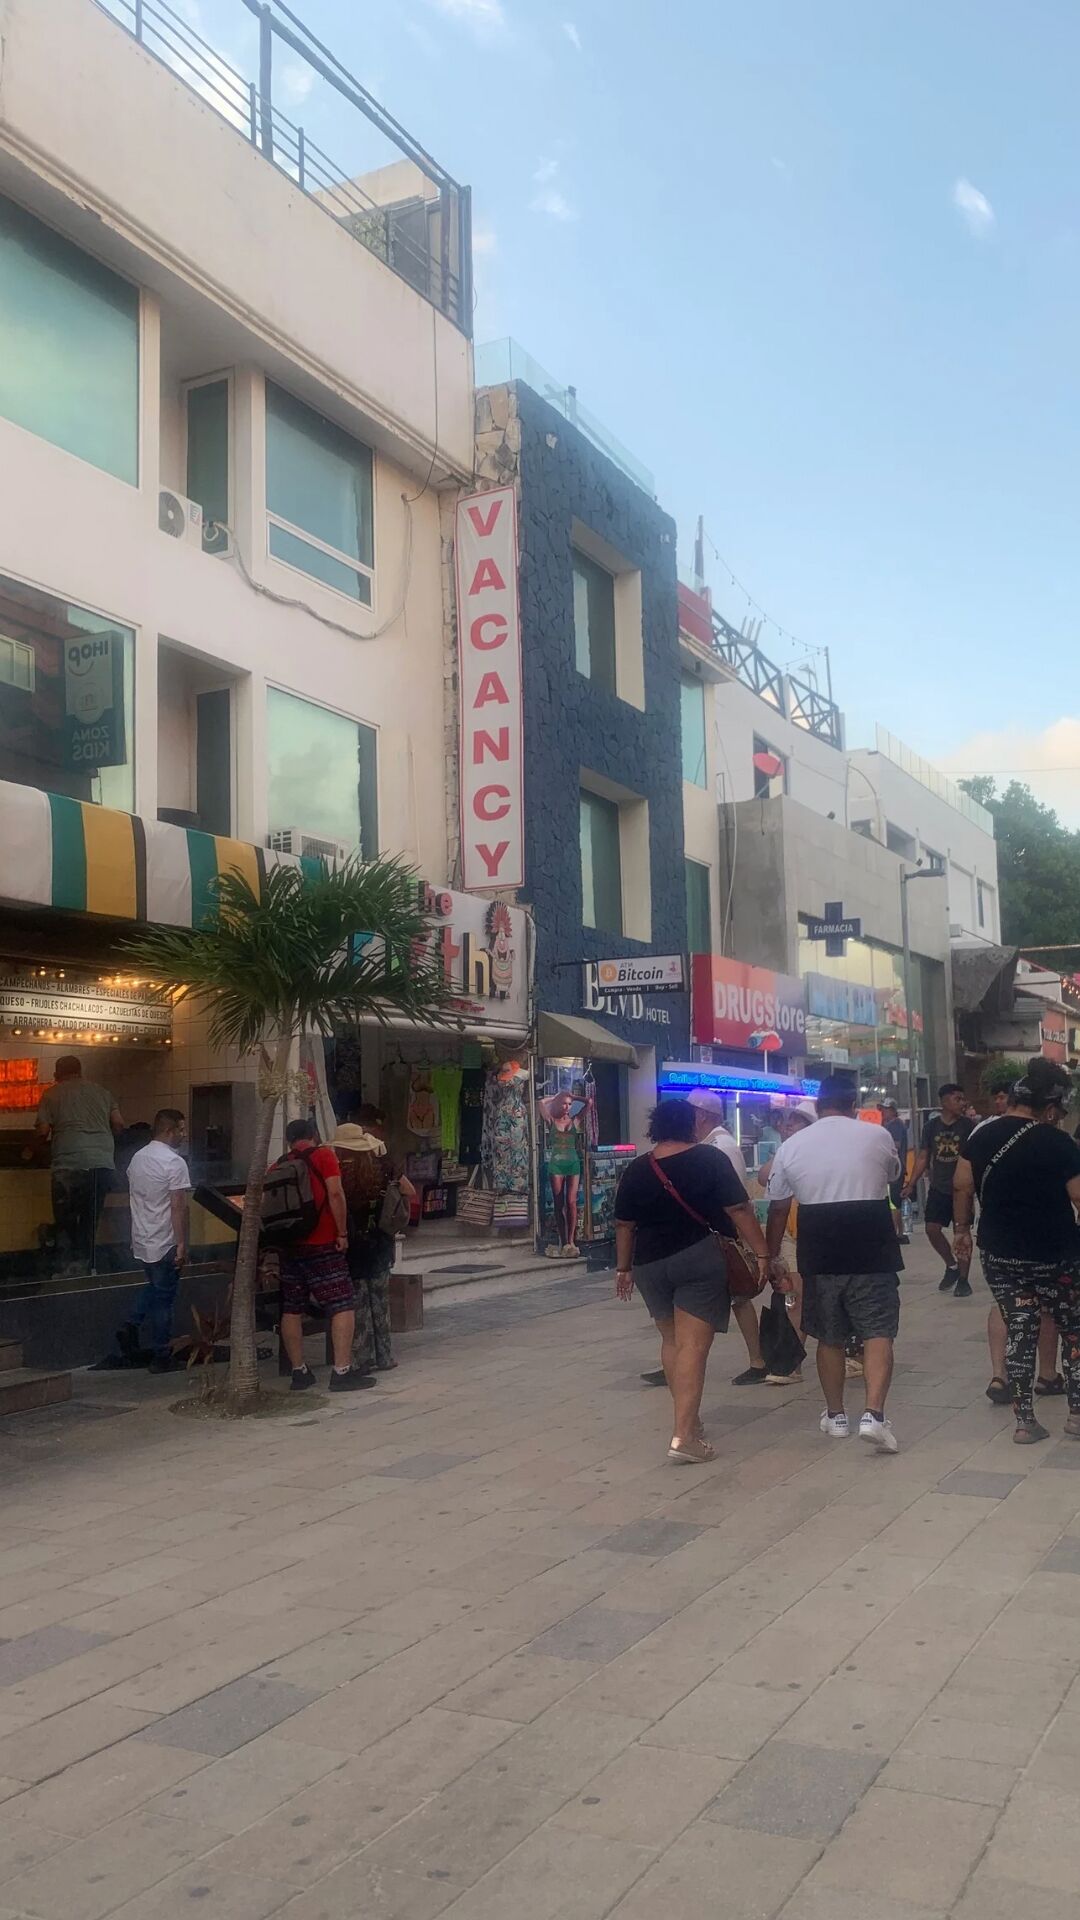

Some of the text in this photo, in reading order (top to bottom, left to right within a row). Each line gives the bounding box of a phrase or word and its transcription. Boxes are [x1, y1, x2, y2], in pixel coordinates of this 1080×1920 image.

[467, 499, 512, 877] VACANCY
[813, 922, 854, 935] FARMACIA
[618, 967, 663, 982] Bitcoin
[57, 982, 90, 995] ALAMBRES
[0, 996, 25, 1007] QUESO
[31, 998, 59, 1010] FRIJOLES
[60, 1001, 103, 1014] CHACHALACOS
[712, 980, 805, 1034] DRUGStore
[14, 1016, 52, 1027] ARRACHERA
[58, 1019, 78, 1029] CALDO
[646, 1007, 671, 1025] HOTEL
